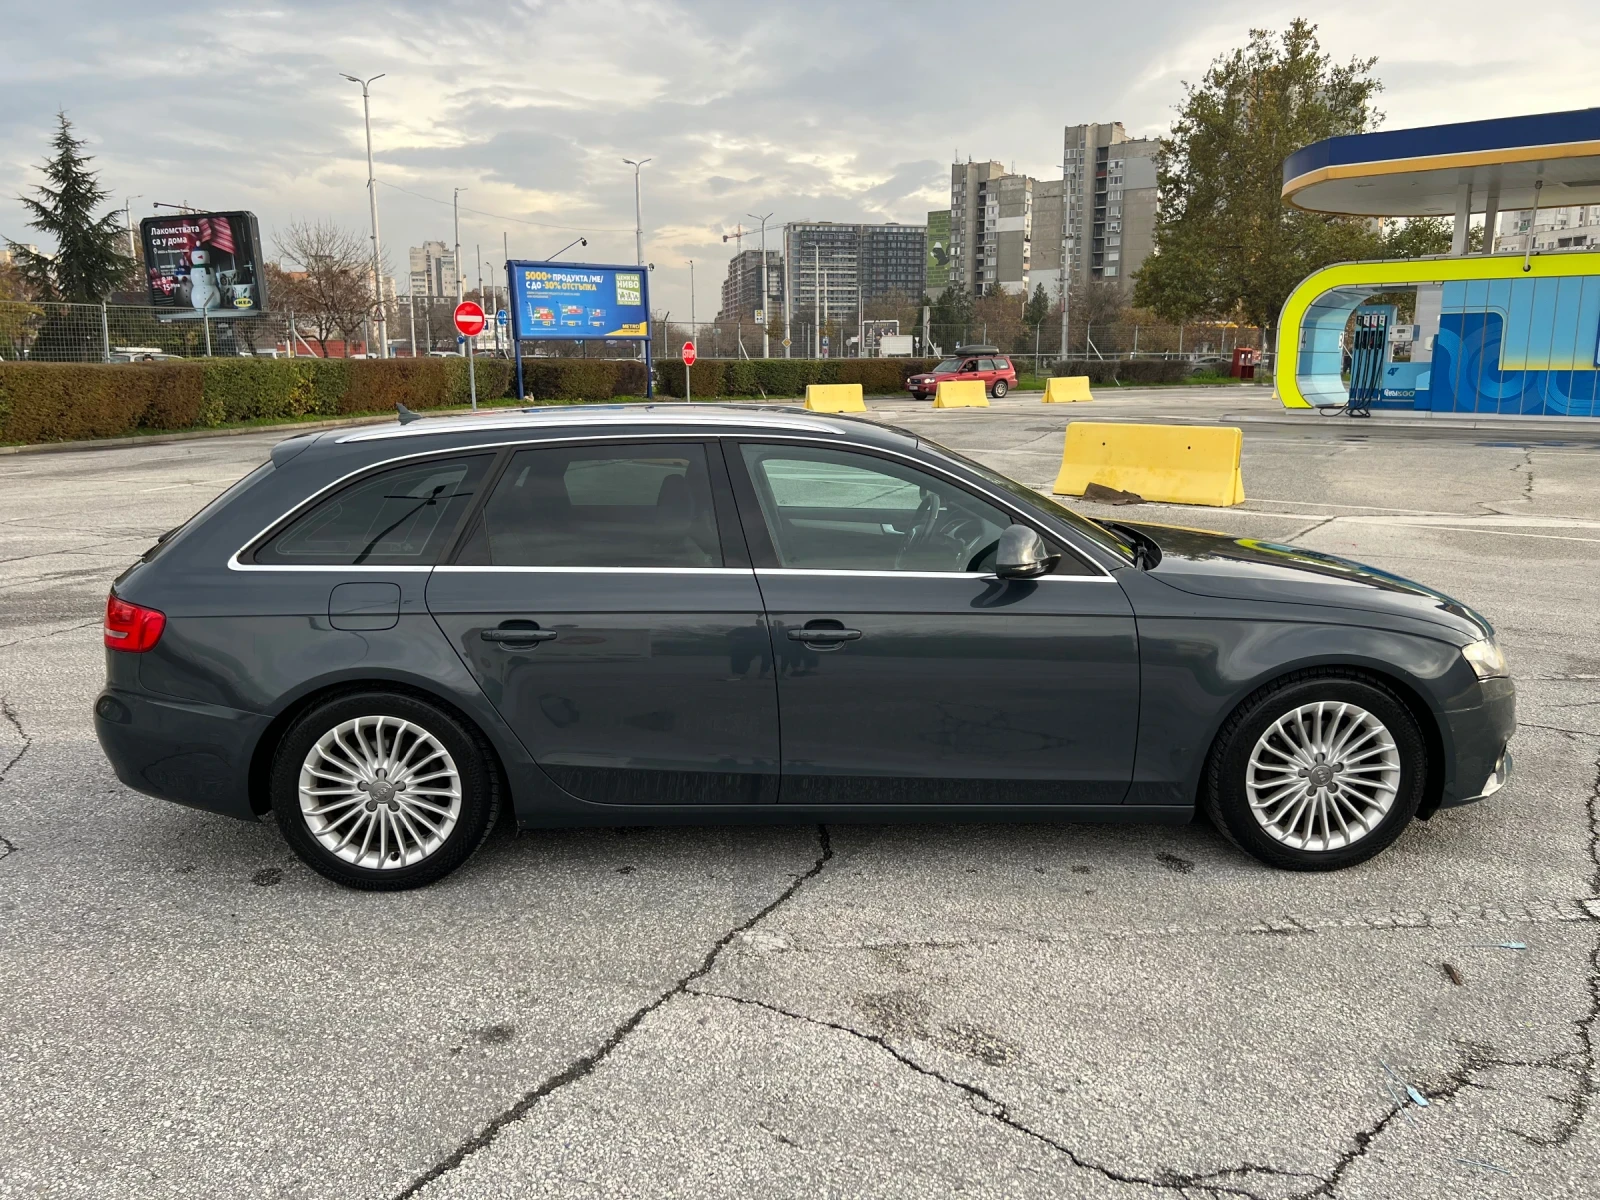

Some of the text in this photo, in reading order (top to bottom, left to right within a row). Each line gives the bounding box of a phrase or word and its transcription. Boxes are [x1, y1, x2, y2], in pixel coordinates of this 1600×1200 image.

[151, 226, 200, 236] Лакомствата
[168, 236, 188, 246] дома
[526, 271, 552, 280] 5000+
[552, 274, 588, 282] ПРОДУКТА
[531, 282, 542, 290] ДО
[562, 282, 597, 291] ОТСТЪПКА
[617, 280, 639, 289] НИВО
